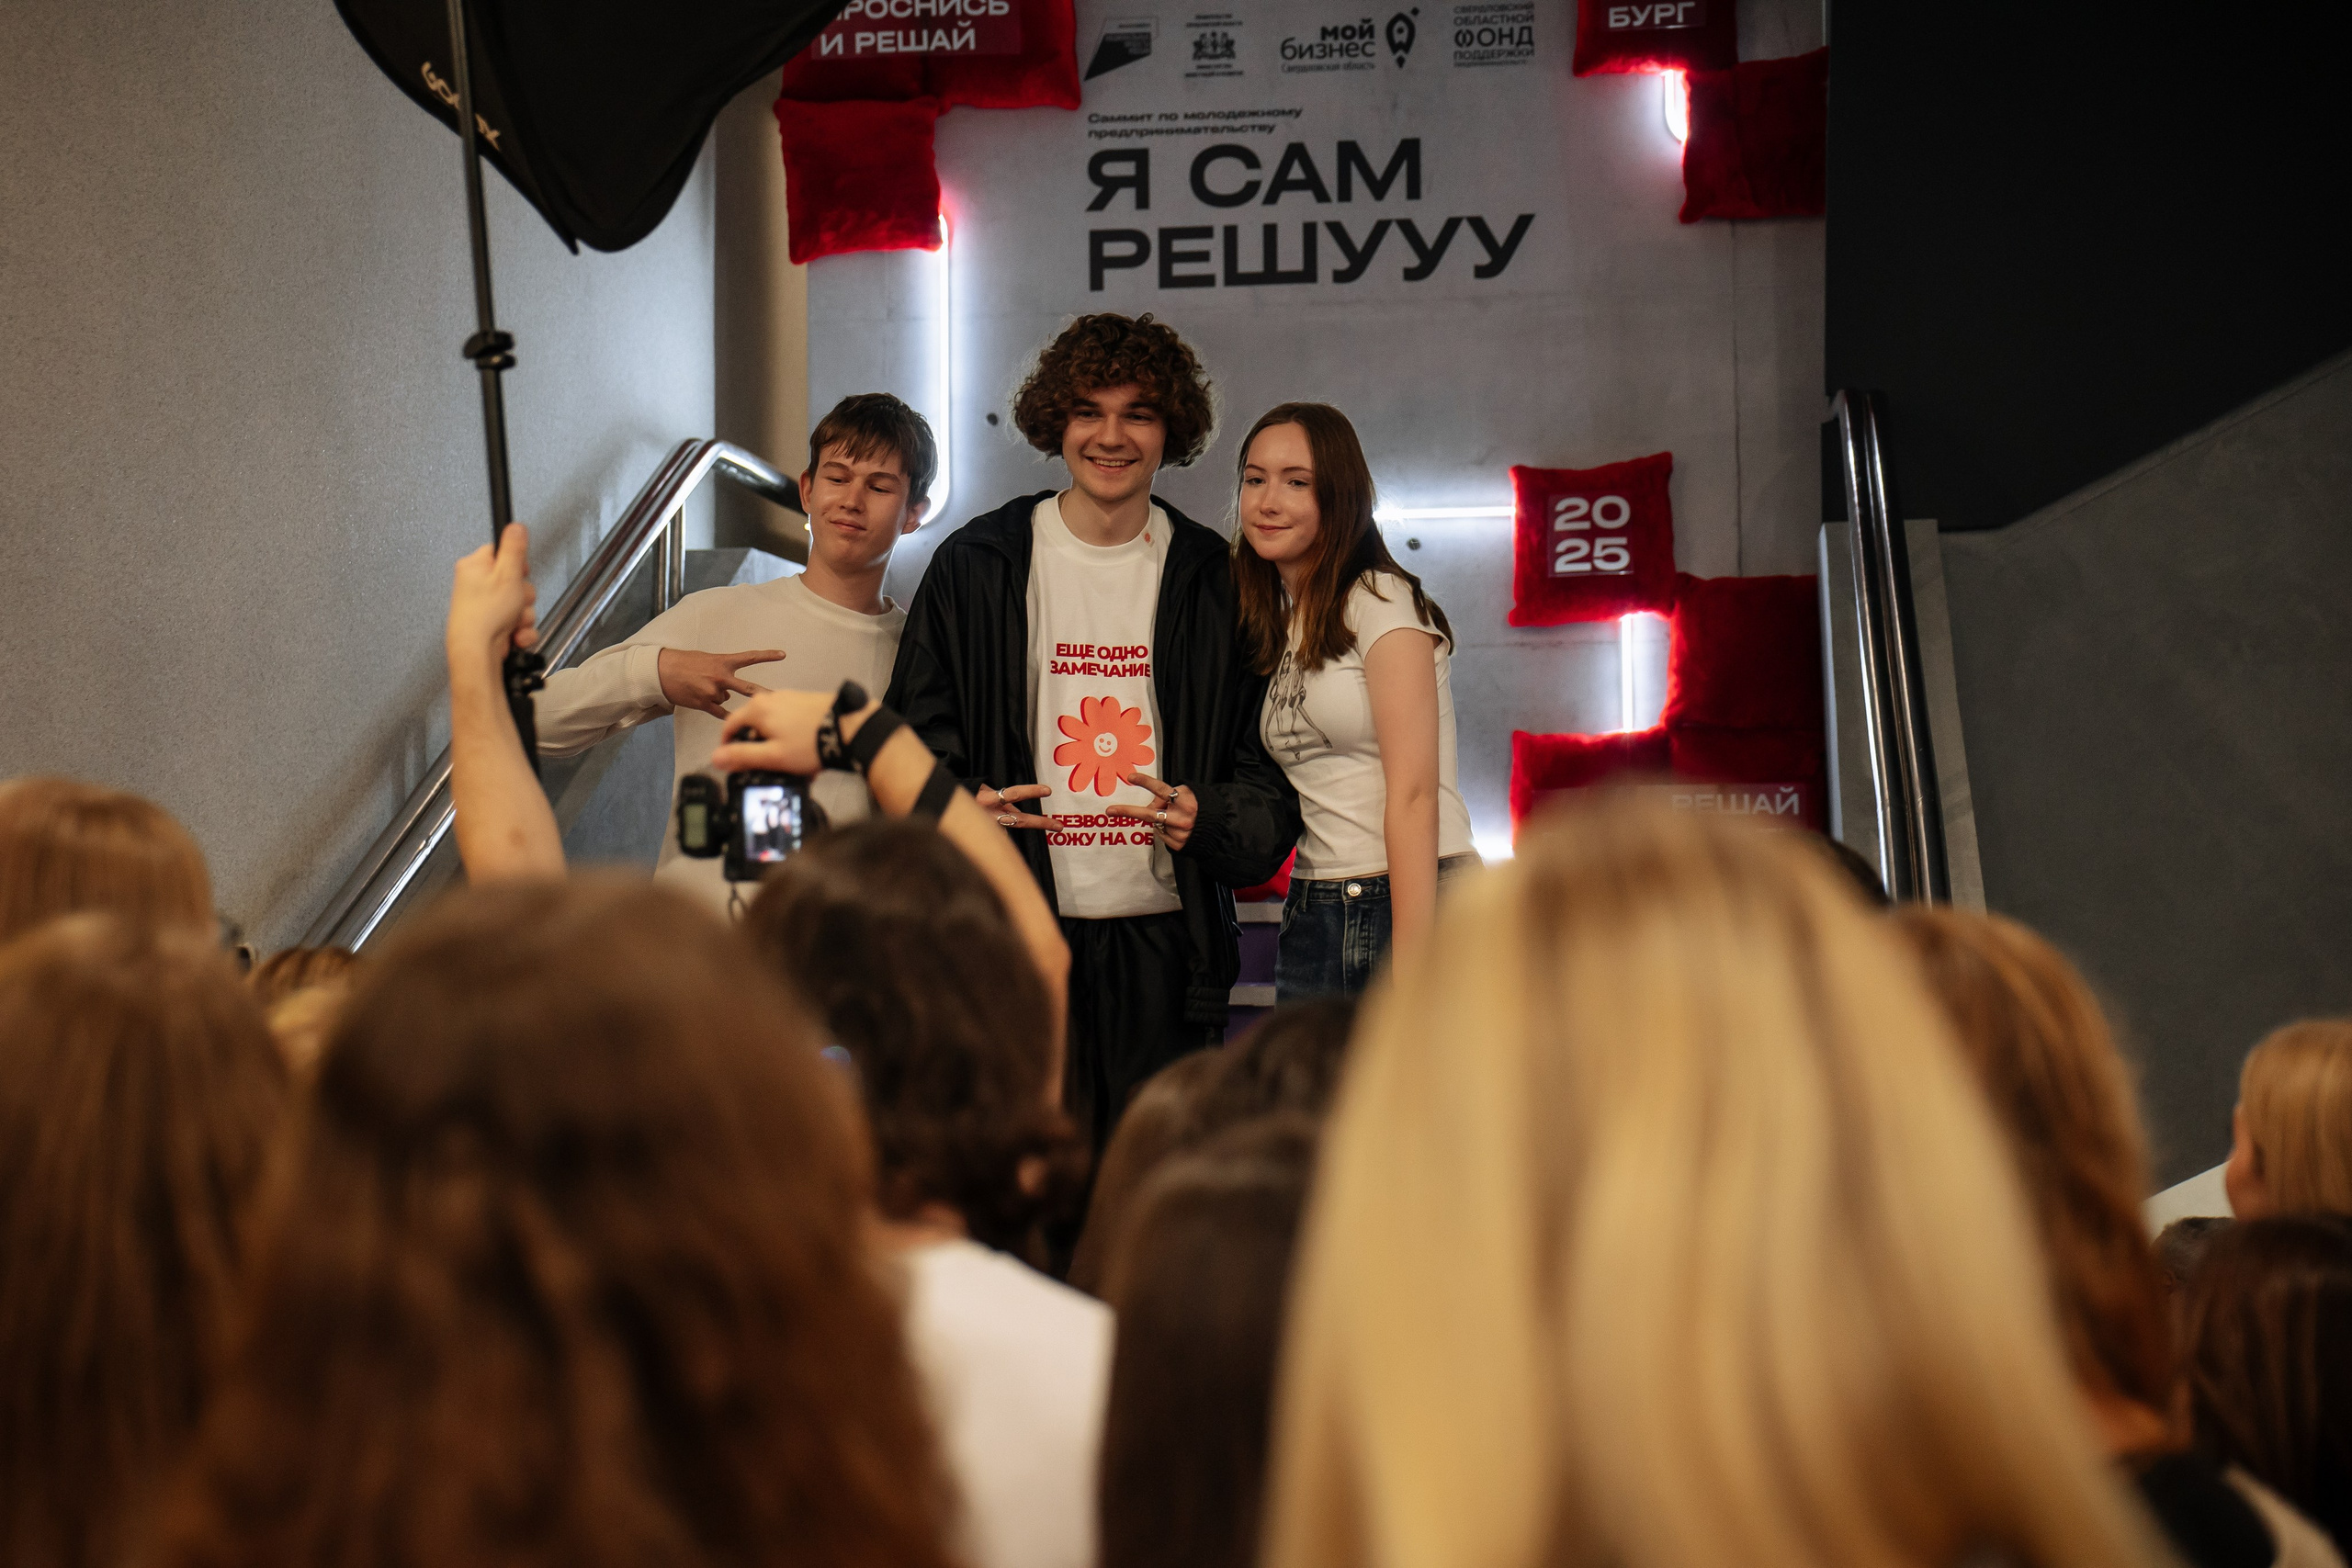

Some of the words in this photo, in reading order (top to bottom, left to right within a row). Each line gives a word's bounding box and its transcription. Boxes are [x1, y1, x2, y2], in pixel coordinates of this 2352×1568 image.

[835, 0, 1010, 21] РОСНИСЬ
[1453, 10, 1534, 26] ОБЛАСТНОЙ
[1608, 1, 1696, 28] БУРГ
[820, 33, 844, 56] И
[854, 20, 976, 54] РЕШАЙ
[1320, 17, 1376, 40] мой
[1453, 26, 1534, 48] ФОНД
[1280, 37, 1376, 61] бизнес
[1088, 113, 1153, 124] Саммит
[1158, 112, 1179, 122] по
[1183, 107, 1303, 120] молодежному
[1088, 123, 1276, 140] предпринимательству
[1086, 148, 1149, 212] Я
[1190, 138, 1421, 209] САМ
[1090, 213, 1535, 292] РЕШУУУ
[1554, 495, 1632, 533] 20
[1554, 537, 1631, 573] 25
[1056, 643, 1095, 660] ЕЩЕ
[1097, 645, 1148, 662] ОДНО
[1050, 660, 1151, 678] ЗАМЕЧАНИЕ
[1100, 831, 1127, 846] НА
